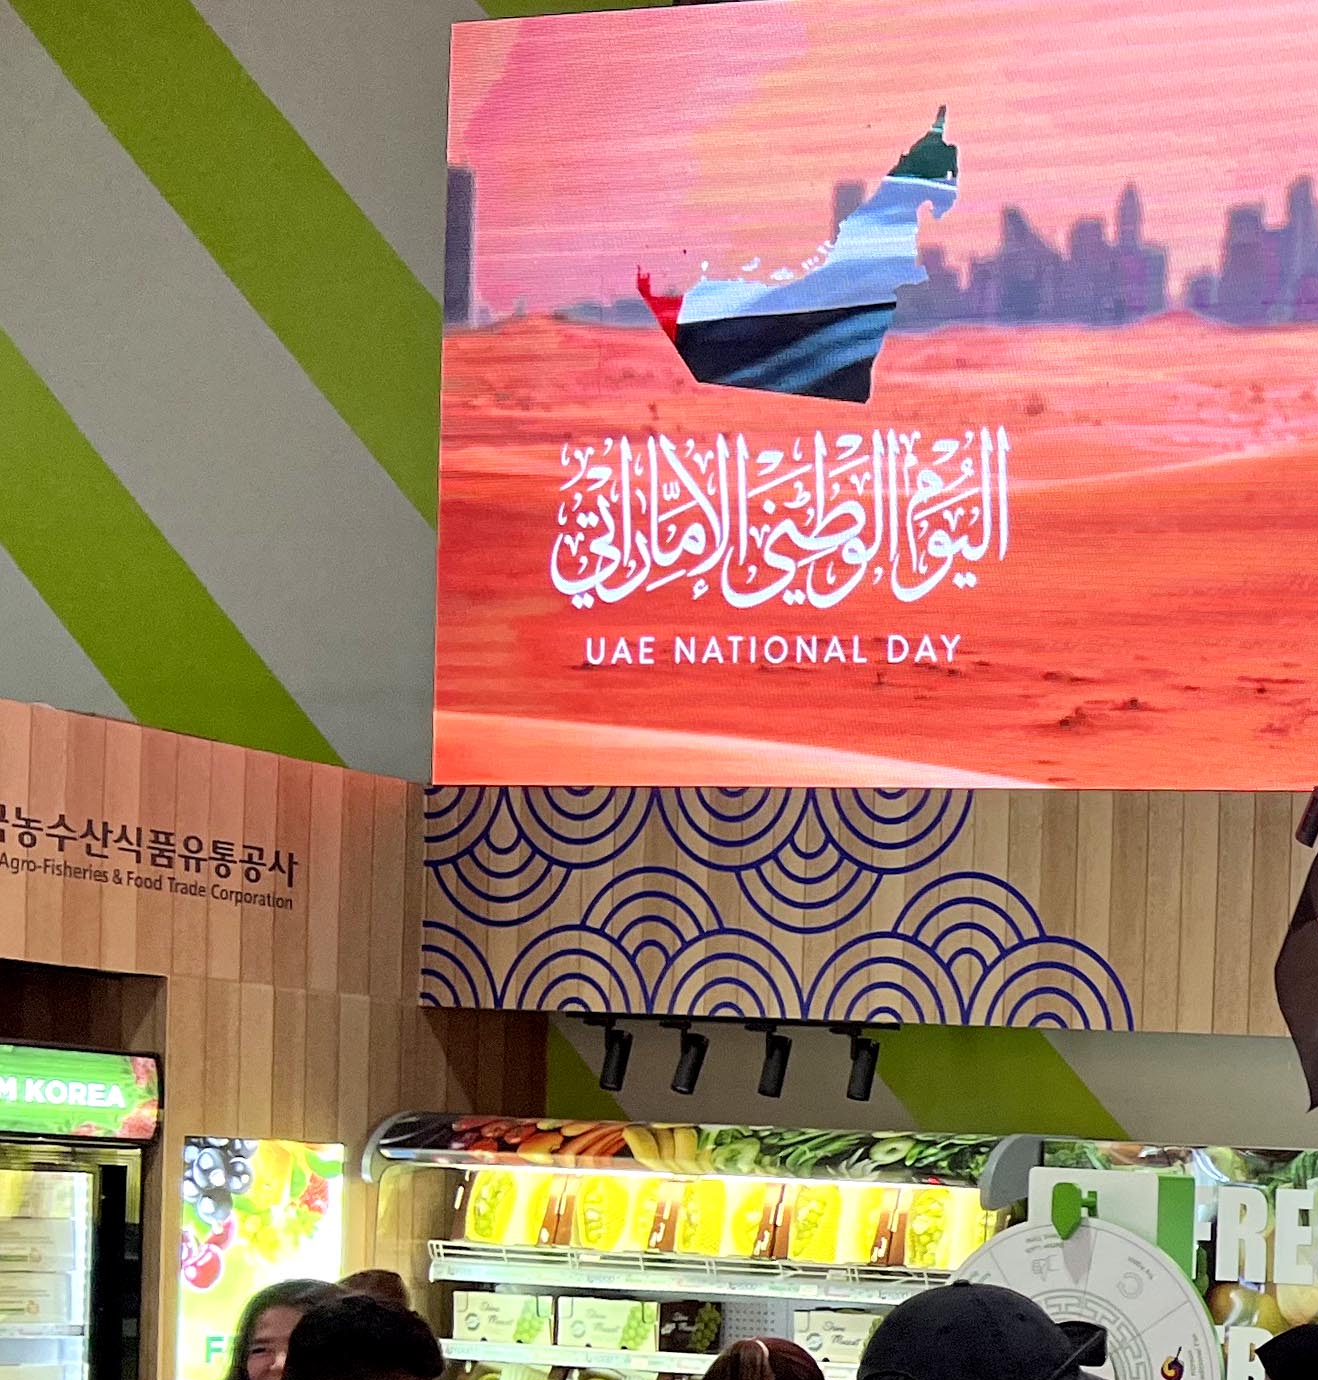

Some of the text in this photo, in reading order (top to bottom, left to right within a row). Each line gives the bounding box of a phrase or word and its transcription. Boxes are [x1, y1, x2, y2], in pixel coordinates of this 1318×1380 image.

[585, 633, 962, 665] UAE NATIONAL DAY
[0, 854, 294, 911] Agro-Fisheries & Food Trade Corporation
[25, 1078, 126, 1108] KOREA
